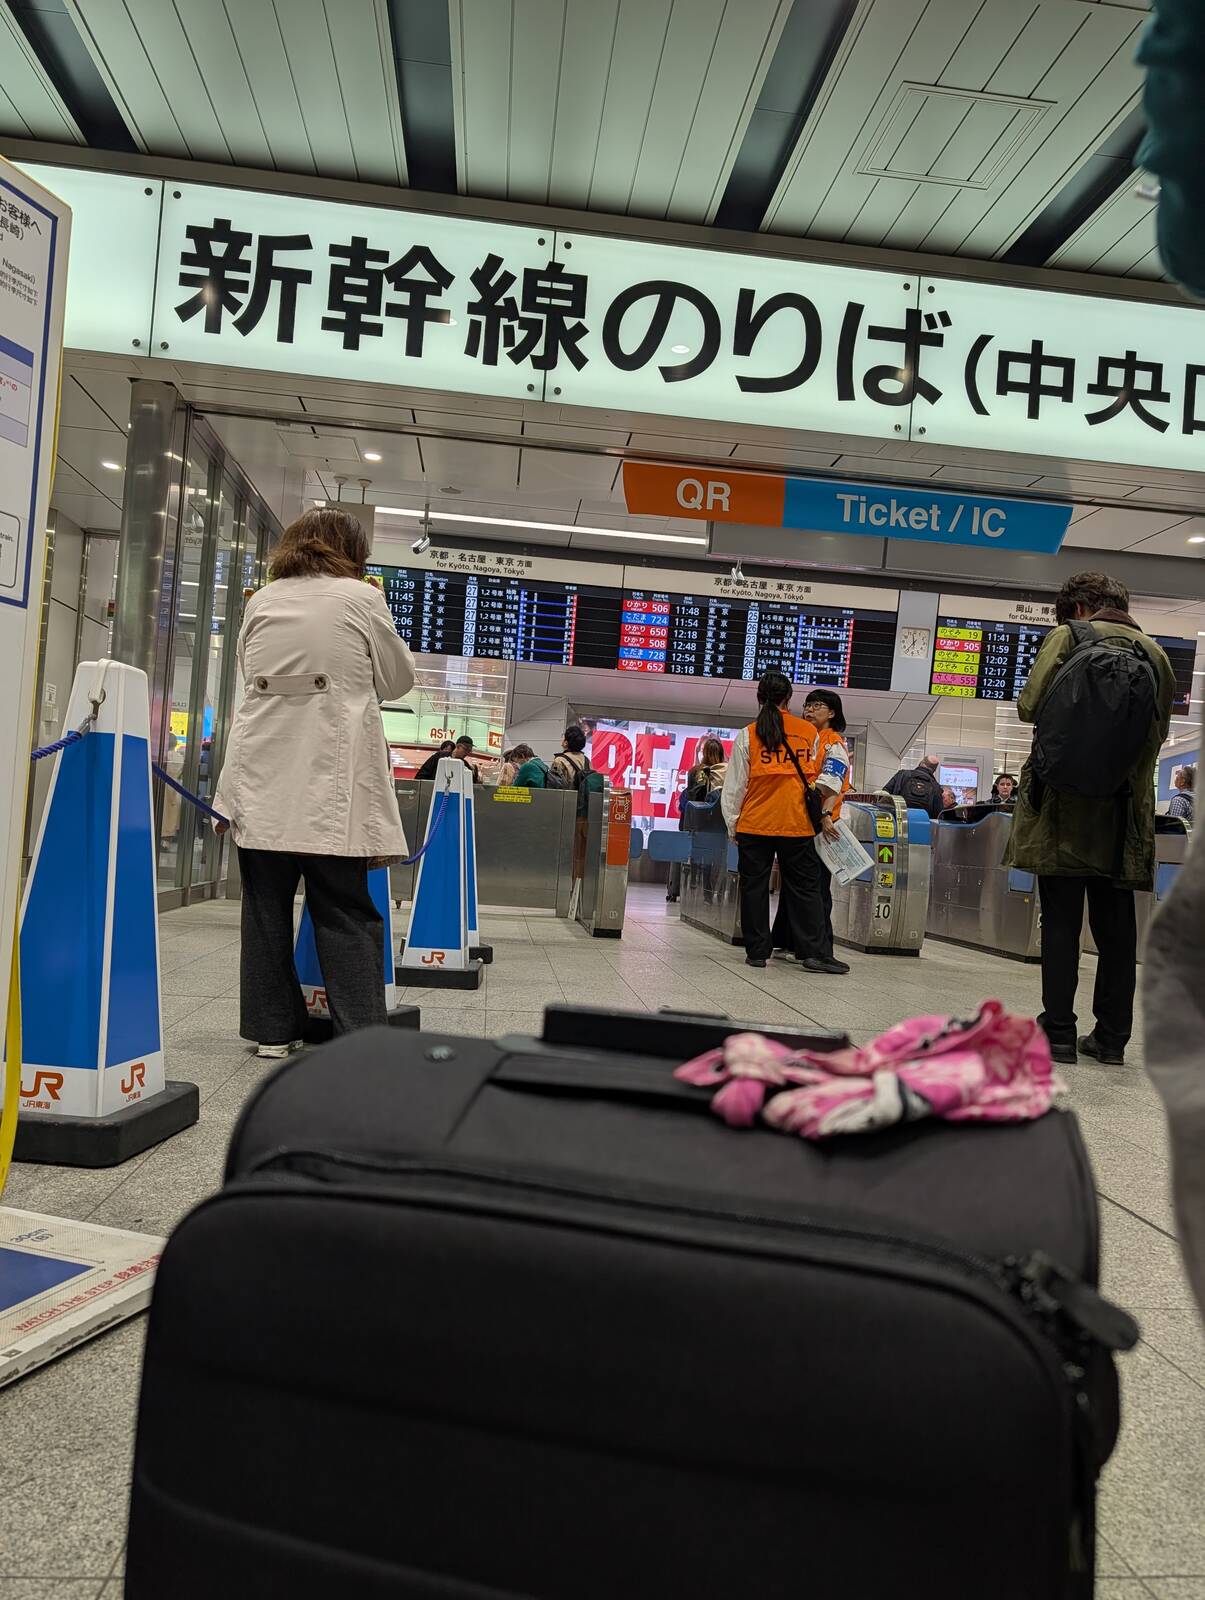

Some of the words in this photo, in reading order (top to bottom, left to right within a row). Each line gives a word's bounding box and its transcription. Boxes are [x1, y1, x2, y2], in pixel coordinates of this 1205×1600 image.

[676, 478, 732, 512] QR
[836, 492, 941, 532] Ticket
[972, 506, 1007, 539] IC
[473, 564, 501, 574] Nagoya,
[390, 579, 415, 589] 11:39
[467, 586, 477, 596] 27
[755, 591, 782, 599] Nagoya,
[389, 592, 414, 601] 11:45
[466, 598, 476, 608] 27
[466, 610, 476, 620] 27
[652, 604, 669, 613] 506
[676, 606, 699, 616] 11:48
[749, 612, 758, 621] 25
[1020, 614, 1050, 623] Okayama,
[393, 616, 413, 625] 2:06
[465, 622, 475, 632] 27
[651, 616, 668, 625] 724
[675, 618, 699, 627] 11:54
[748, 623, 757, 633] 26
[464, 634, 474, 644] 26
[625, 624, 646, 632] ひかり
[650, 628, 667, 636] 650
[674, 630, 698, 639] 12:18
[747, 635, 756, 645] 23
[968, 631, 978, 639] 19
[988, 633, 1010, 642] 11:41
[463, 646, 473, 656] 27
[624, 636, 645, 644] ひかり
[649, 639, 666, 648] 508
[673, 641, 697, 651] 12:48
[746, 647, 755, 656] 25
[964, 643, 980, 651] 505
[987, 645, 1009, 654] 11:59
[648, 651, 665, 660] 728
[672, 653, 696, 662] 12:54
[745, 658, 754, 668] 26
[965, 654, 975, 662] 21
[985, 656, 1008, 665] 12:02
[647, 663, 664, 672] 652
[671, 665, 695, 674] 13:18
[743, 670, 753, 679] 23
[964, 665, 974, 673] 65
[984, 667, 1007, 676] 12:17
[960, 676, 976, 685] 555
[983, 679, 1005, 687] 12:20
[960, 688, 974, 696] 133
[982, 690, 1004, 699] 12:32
[875, 904, 890, 919] 10
[421, 951, 446, 964] JR
[303, 990, 327, 1009] JR
[20, 1071, 64, 1101] JR
[121, 1062, 146, 1094] JR
[12, 1306, 61, 1332] WATCH
[61, 1295, 86, 1309] THE
[84, 1279, 113, 1296] STEP
